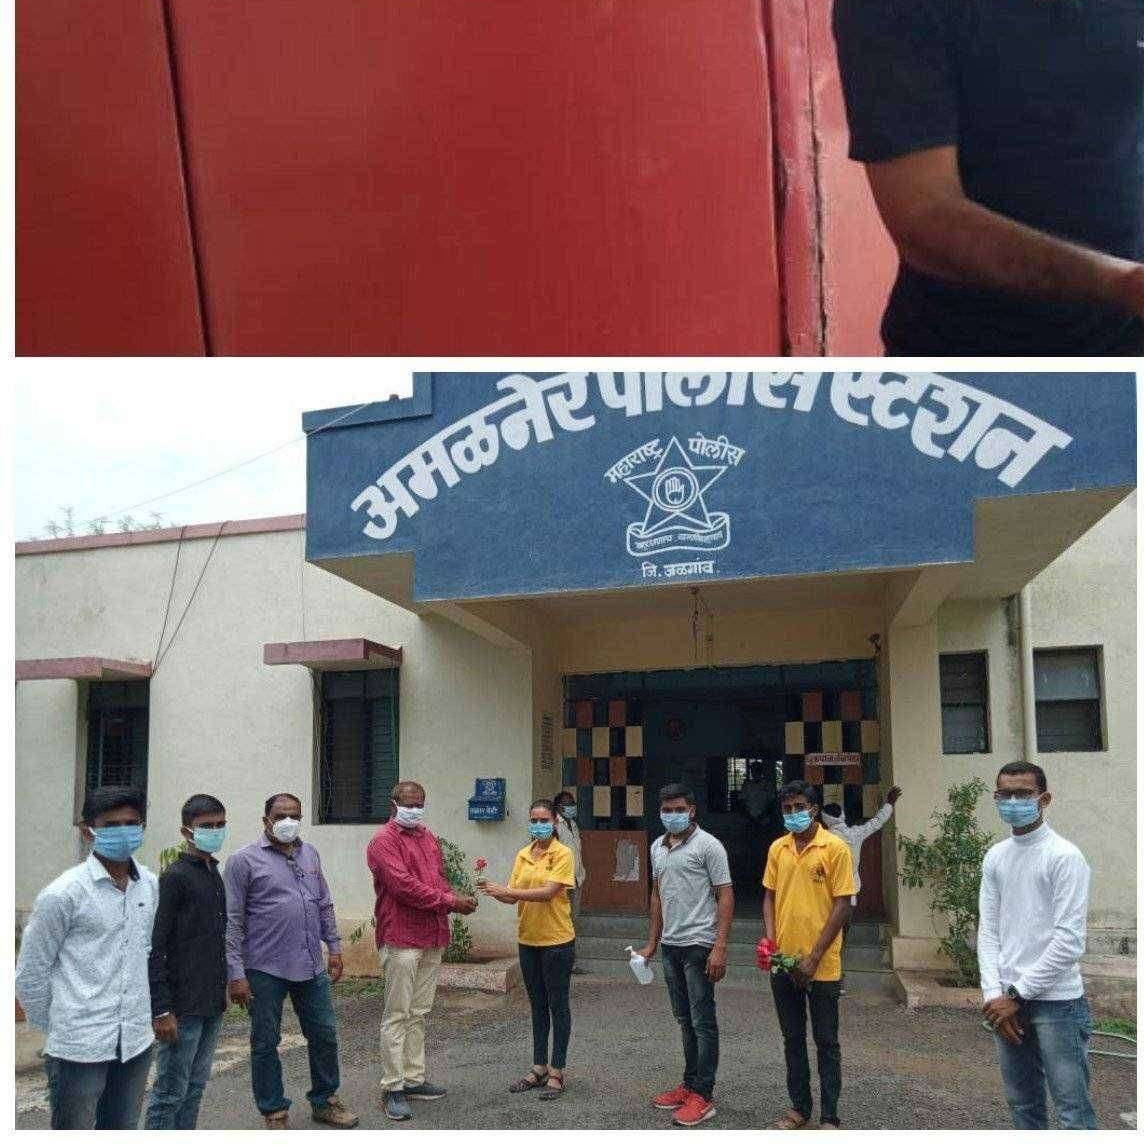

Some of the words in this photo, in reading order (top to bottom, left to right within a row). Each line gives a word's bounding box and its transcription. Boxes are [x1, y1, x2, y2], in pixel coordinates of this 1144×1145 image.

[350, 372, 597, 539] अमळनेर
[829, 372, 1073, 488] स्टशन
[604, 438, 664, 483] महाराष्ट्र
[688, 431, 746, 467] पोलीस
